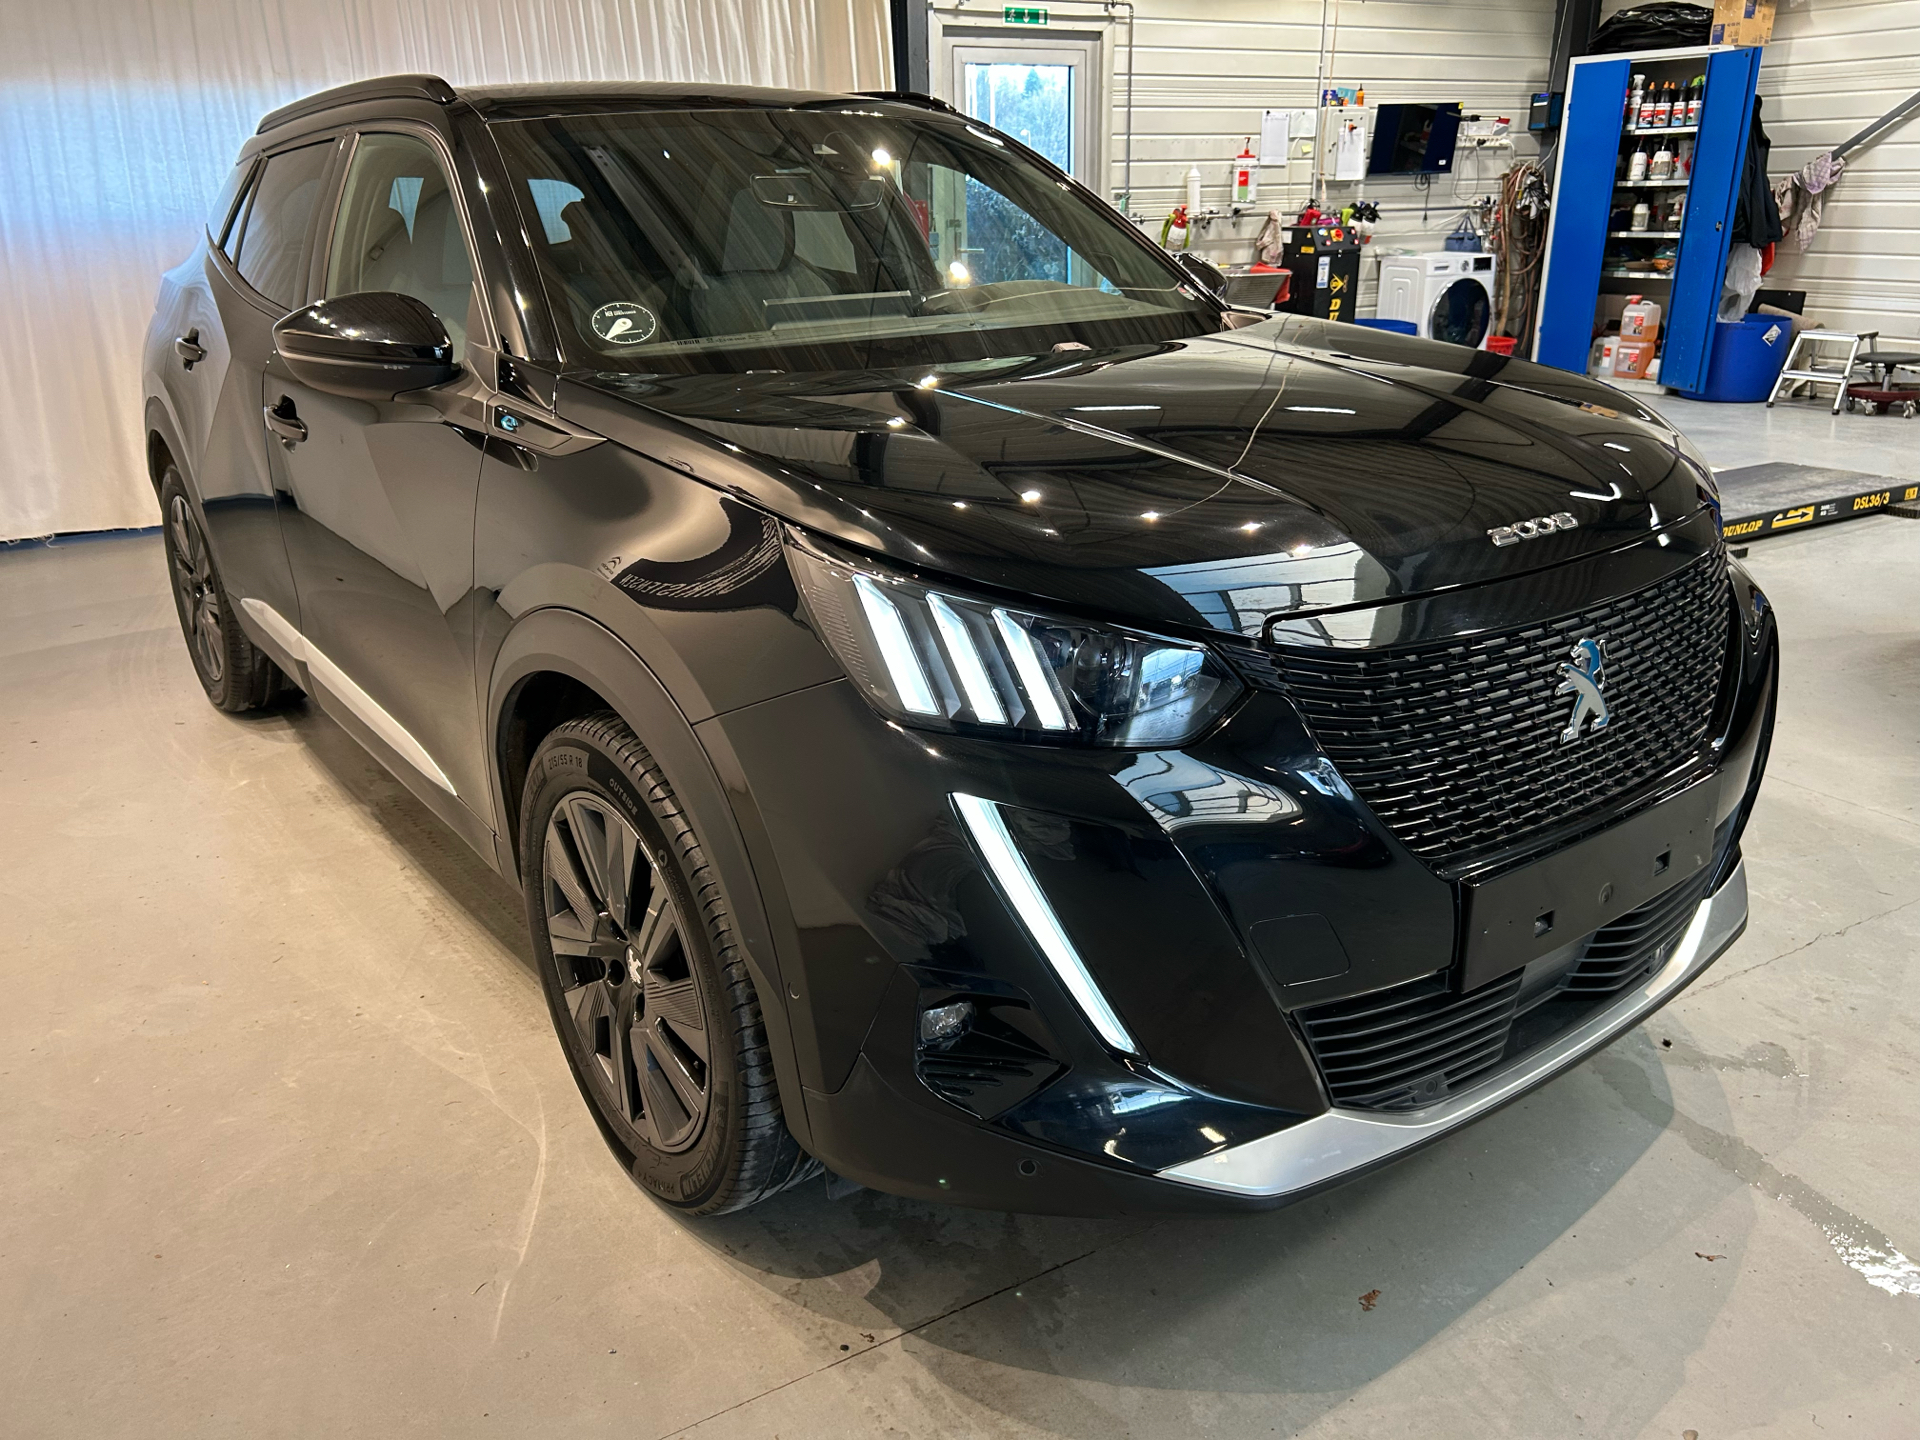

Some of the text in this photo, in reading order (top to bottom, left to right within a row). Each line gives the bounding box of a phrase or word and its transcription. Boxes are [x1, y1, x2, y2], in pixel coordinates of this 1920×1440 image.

[1853, 491, 1890, 511] DSL36/3
[1486, 511, 1579, 547] 2008
[575, 756, 583, 768] 18
[608, 778, 638, 815] OUTSIDE
